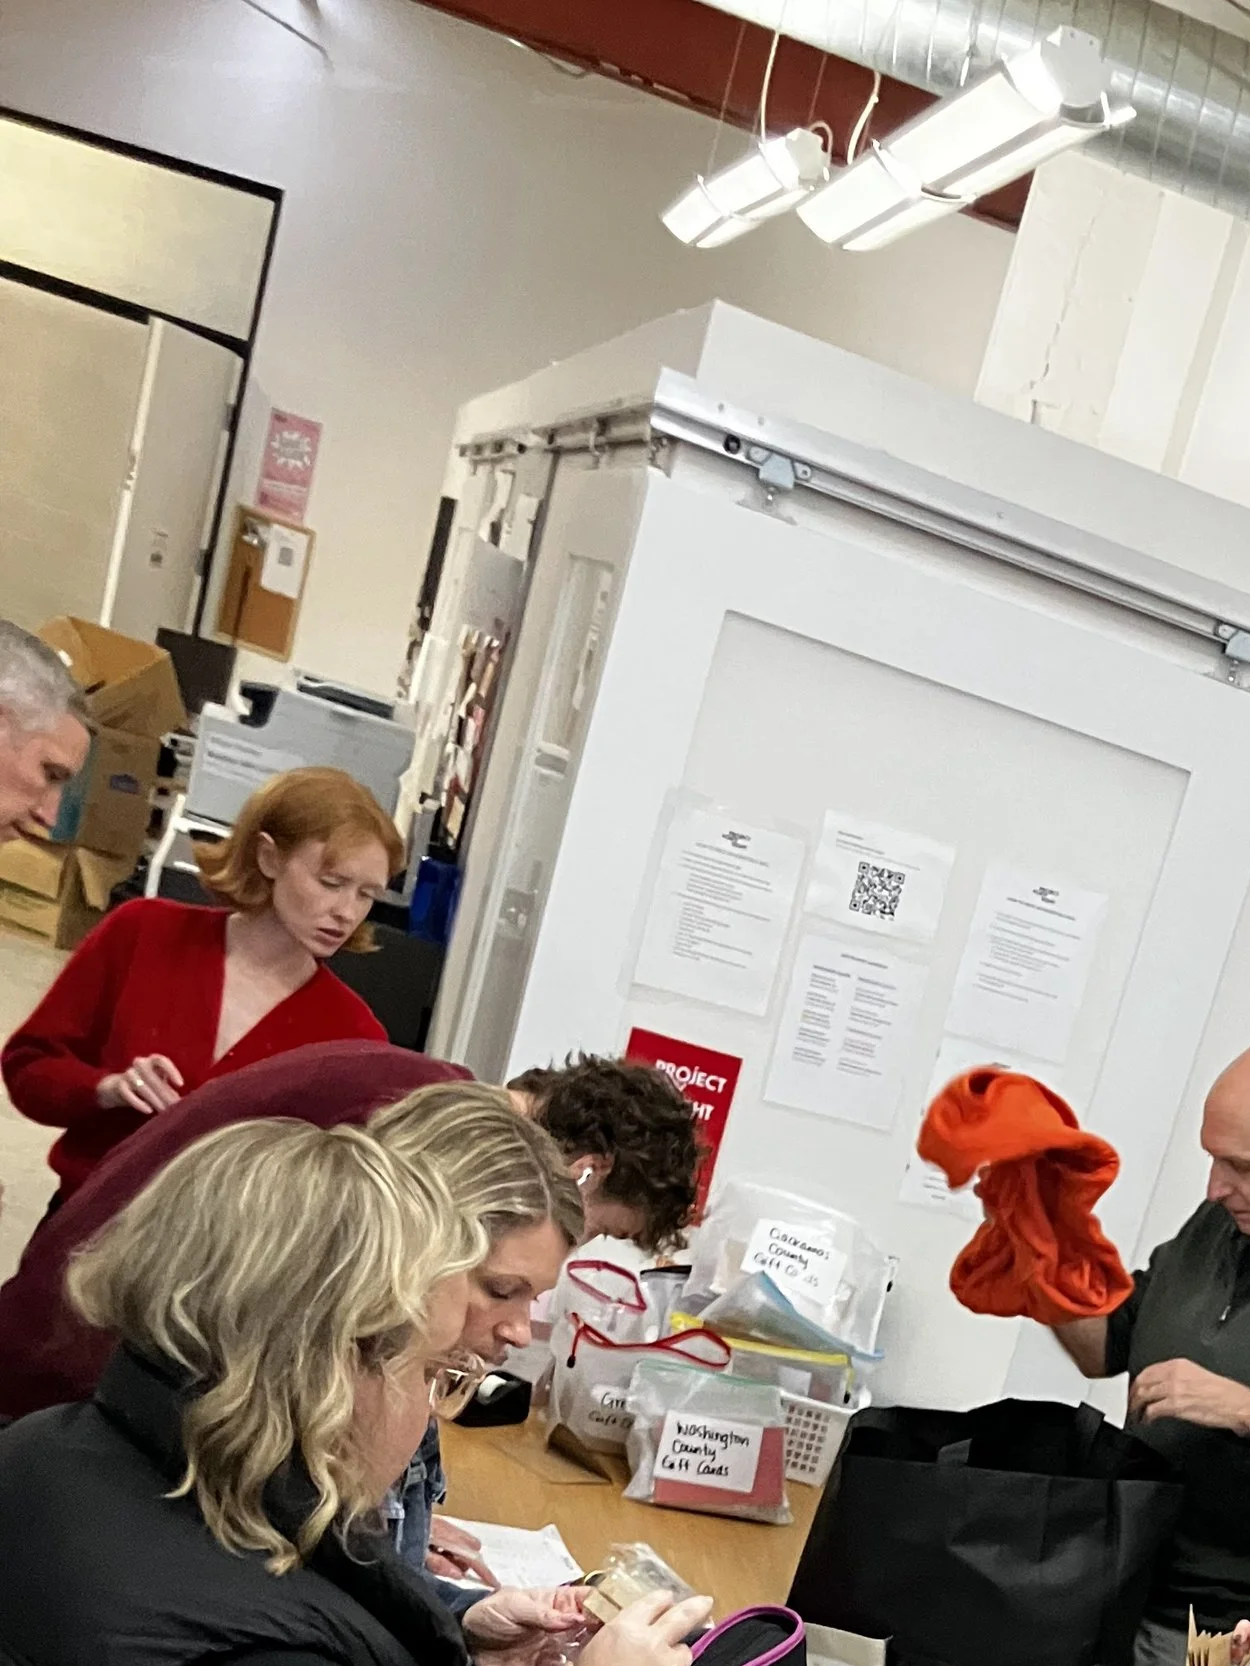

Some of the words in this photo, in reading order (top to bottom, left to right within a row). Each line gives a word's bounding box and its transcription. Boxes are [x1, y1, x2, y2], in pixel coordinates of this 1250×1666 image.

[655, 1059, 727, 1093] PROJECT
[768, 1243, 809, 1270] County
[677, 1422, 750, 1450] Washington
[672, 1439, 717, 1462] County
[697, 1460, 729, 1476] Cards
